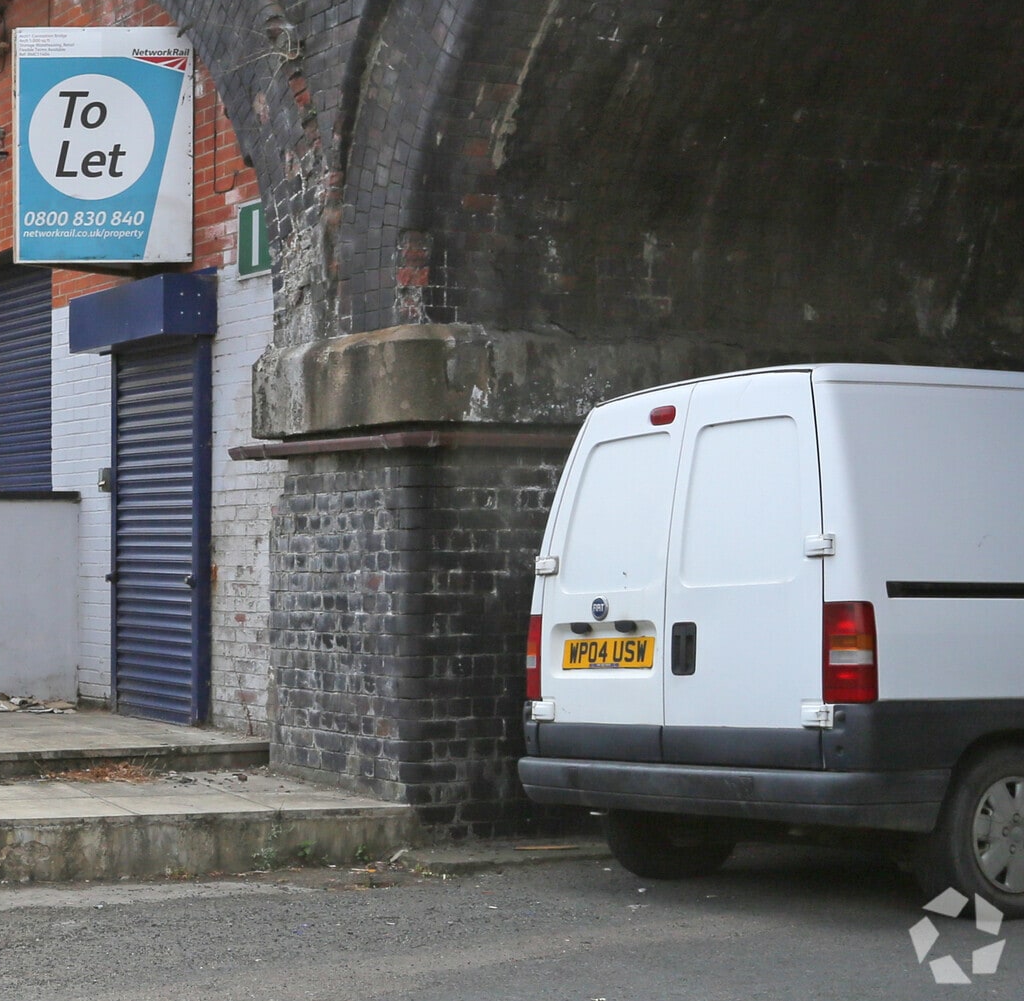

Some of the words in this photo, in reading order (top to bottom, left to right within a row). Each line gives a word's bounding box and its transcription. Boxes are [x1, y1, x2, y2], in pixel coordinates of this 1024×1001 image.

[59, 91, 107, 129] To
[56, 140, 126, 177] Let
[24, 211, 68, 226] 0800
[72, 211, 107, 226] 830
[110, 210, 145, 226] 840
[23, 229, 144, 239] networkrail.co.uk/property
[569, 641, 608, 664] WP04
[612, 640, 647, 662] USW
